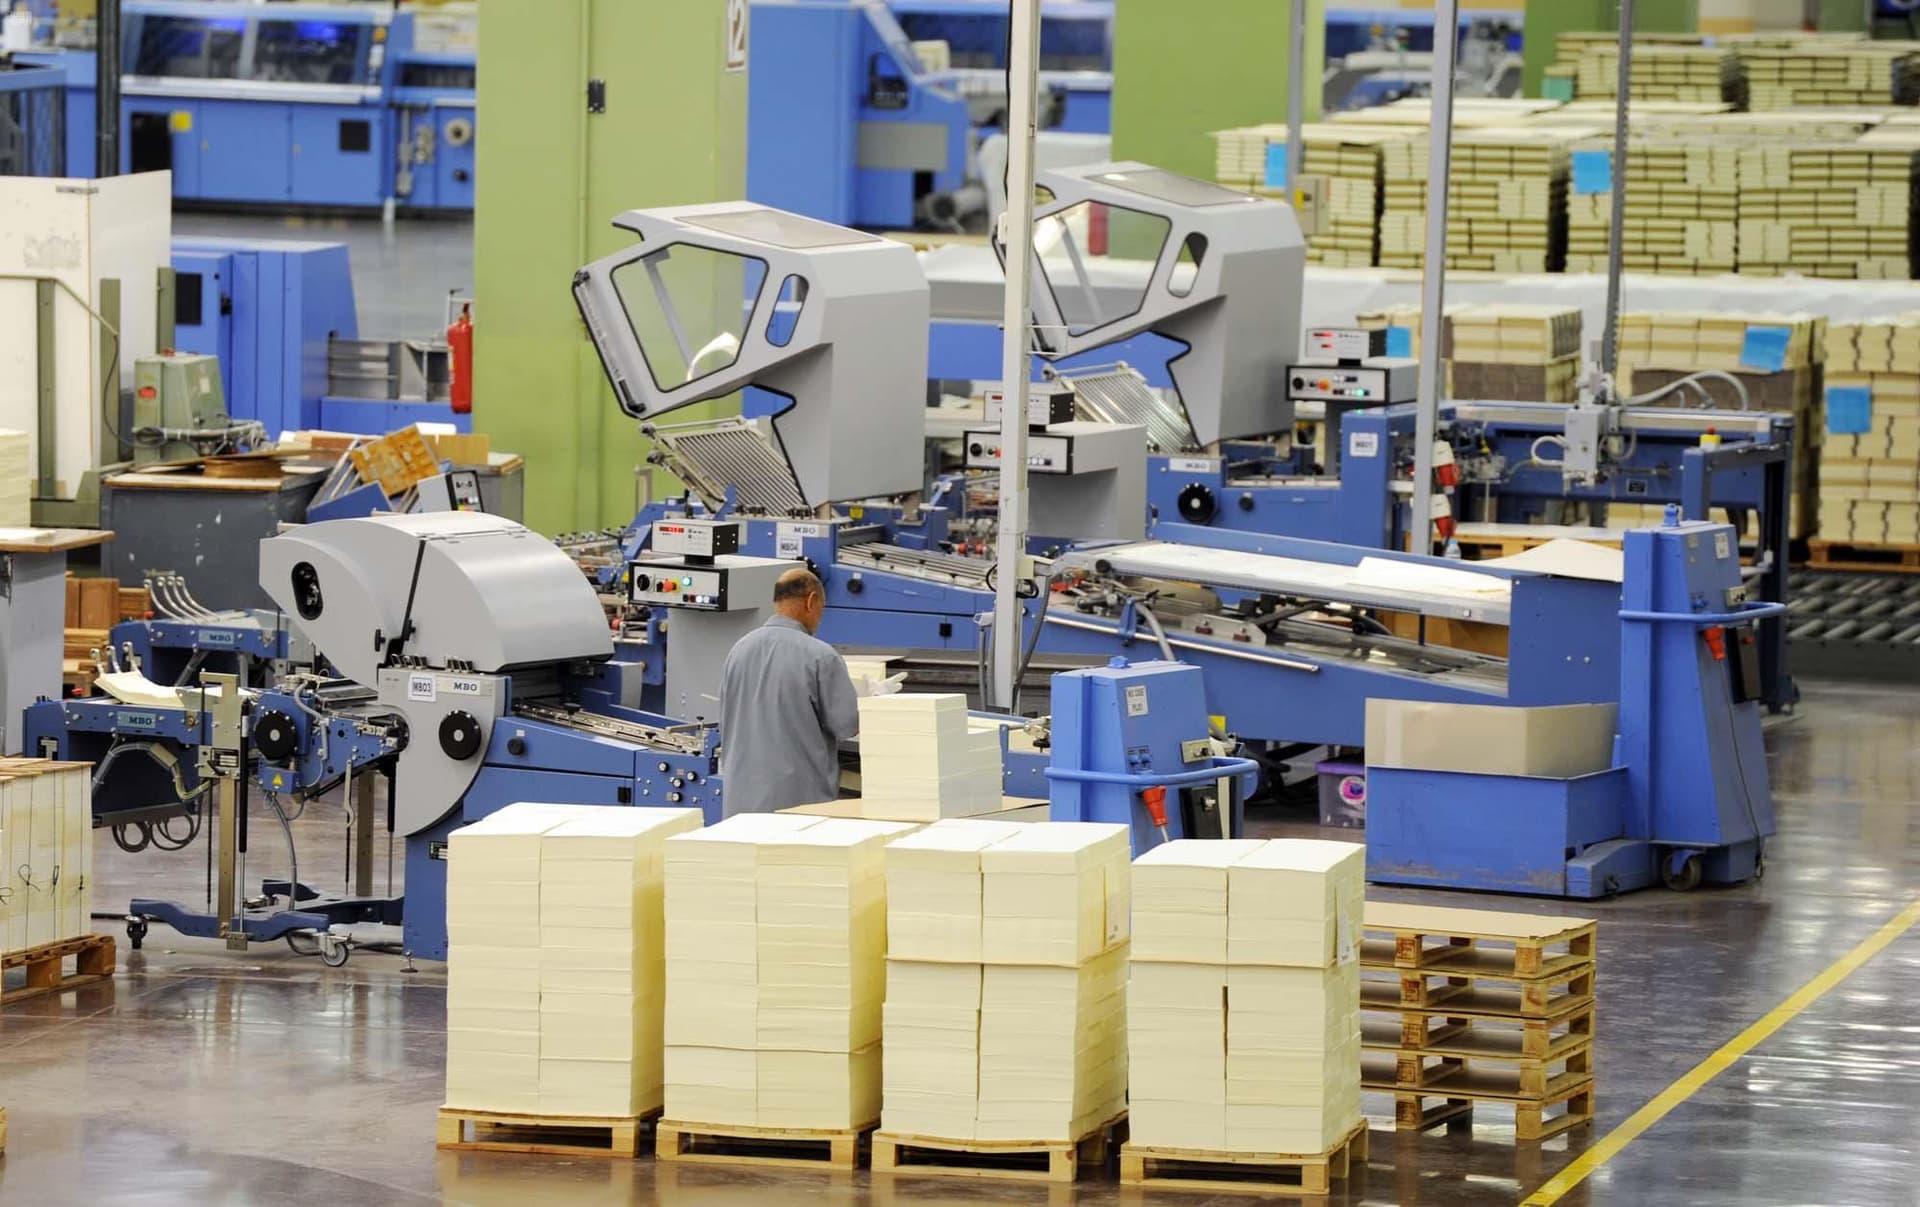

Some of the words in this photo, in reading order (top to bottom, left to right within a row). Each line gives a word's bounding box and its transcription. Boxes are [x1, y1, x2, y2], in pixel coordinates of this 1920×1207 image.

[794, 527, 817, 535] MBO
[453, 682, 478, 692] MBO
[129, 716, 153, 726] MBO
